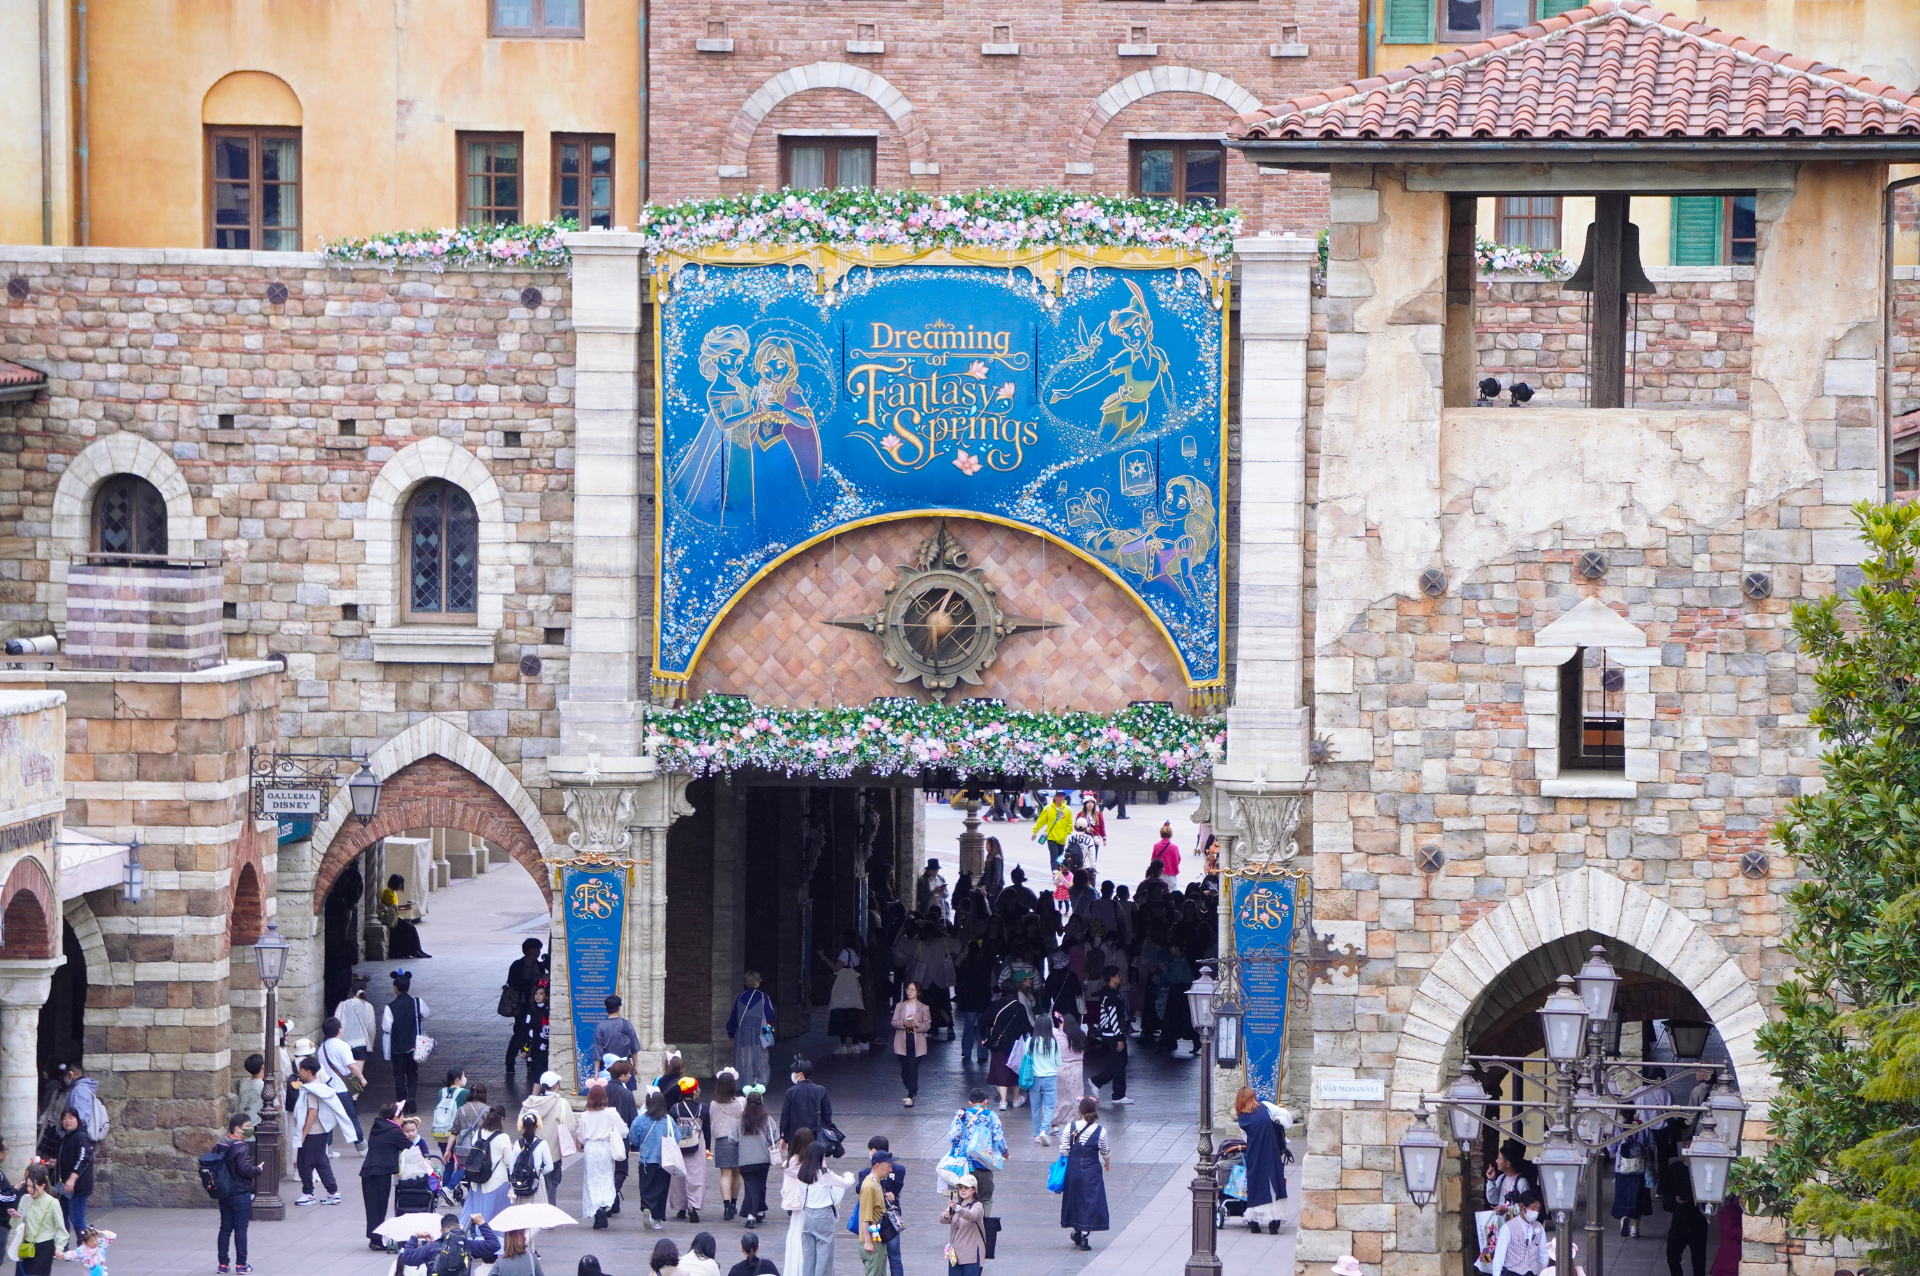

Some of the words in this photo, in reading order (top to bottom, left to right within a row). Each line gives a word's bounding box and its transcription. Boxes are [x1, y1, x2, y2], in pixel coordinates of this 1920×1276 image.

[870, 322, 1010, 356] Dreaming
[930, 351, 950, 366] of
[847, 357, 999, 430] Fantasy
[882, 407, 1037, 471] Springs
[267, 792, 316, 800] GALLERIA
[273, 801, 309, 809] DISNEY
